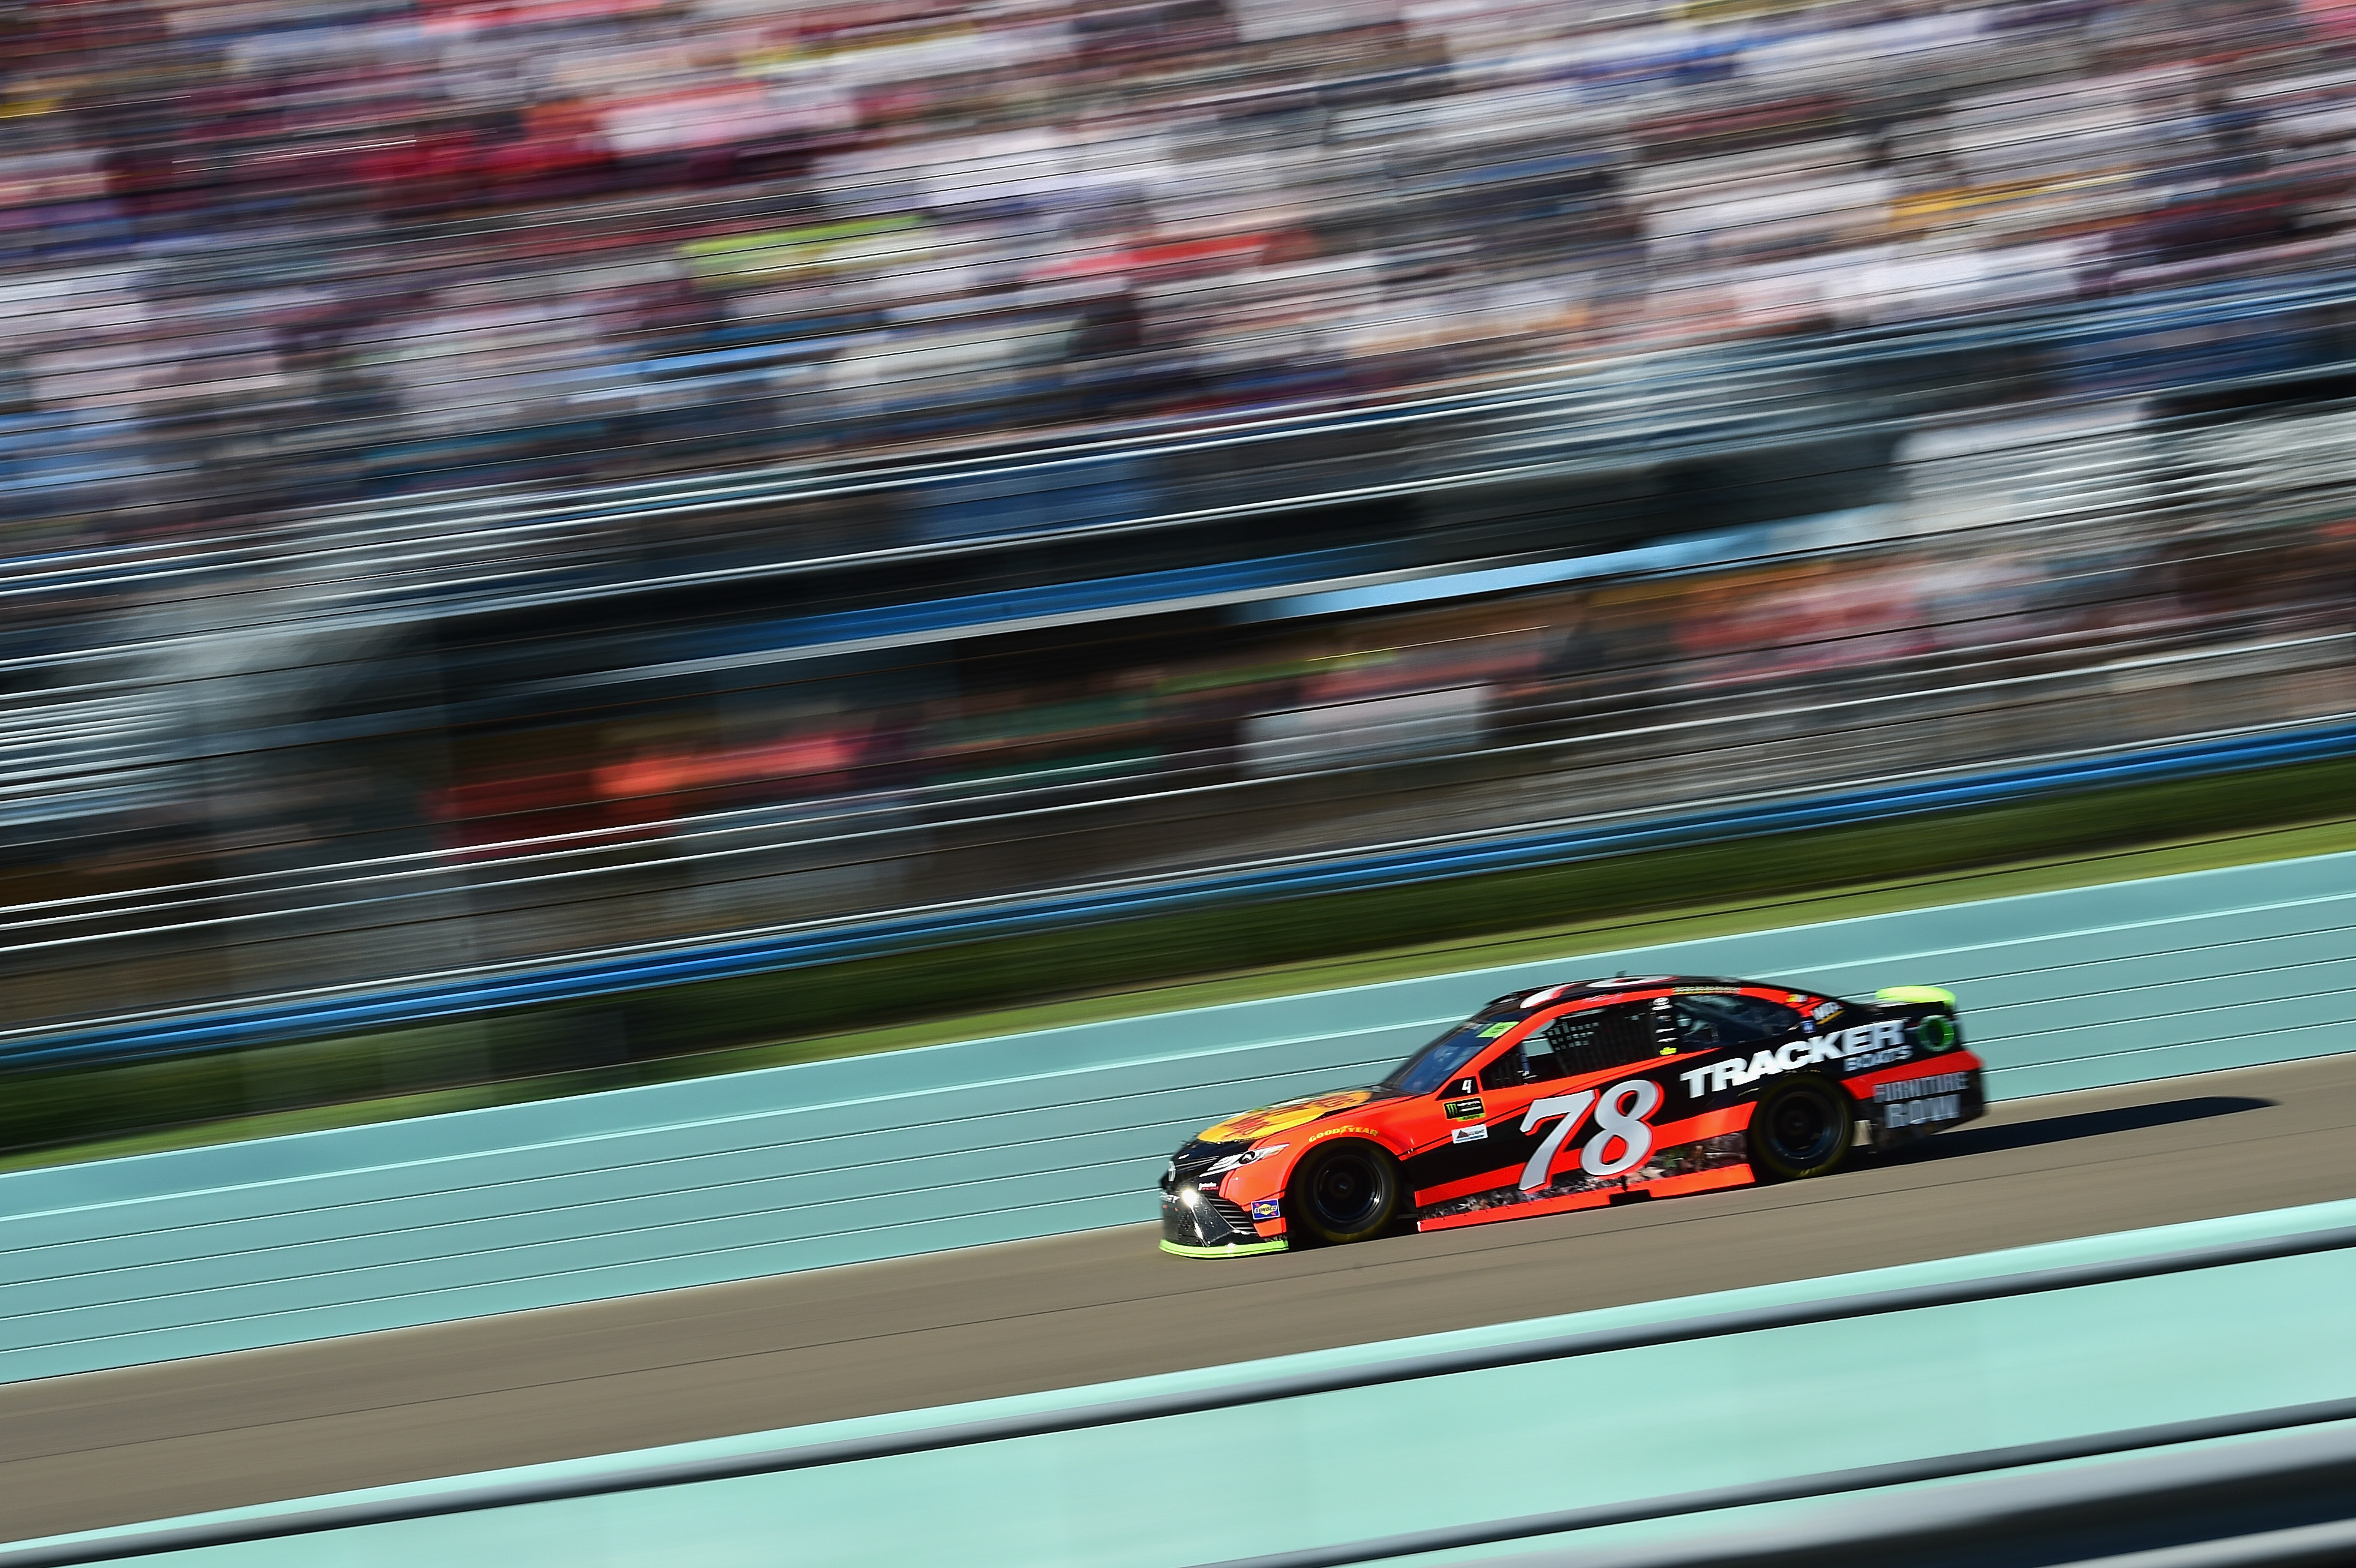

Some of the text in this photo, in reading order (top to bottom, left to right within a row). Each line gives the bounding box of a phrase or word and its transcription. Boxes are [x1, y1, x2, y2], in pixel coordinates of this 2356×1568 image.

[1680, 1018, 1909, 1098] TRACKER
[1844, 1045, 1914, 1072] BOATS
[1461, 1079, 1472, 1094] 4
[1308, 1125, 1379, 1143] GOODYEAR
[1518, 1079, 1661, 1191] 78
